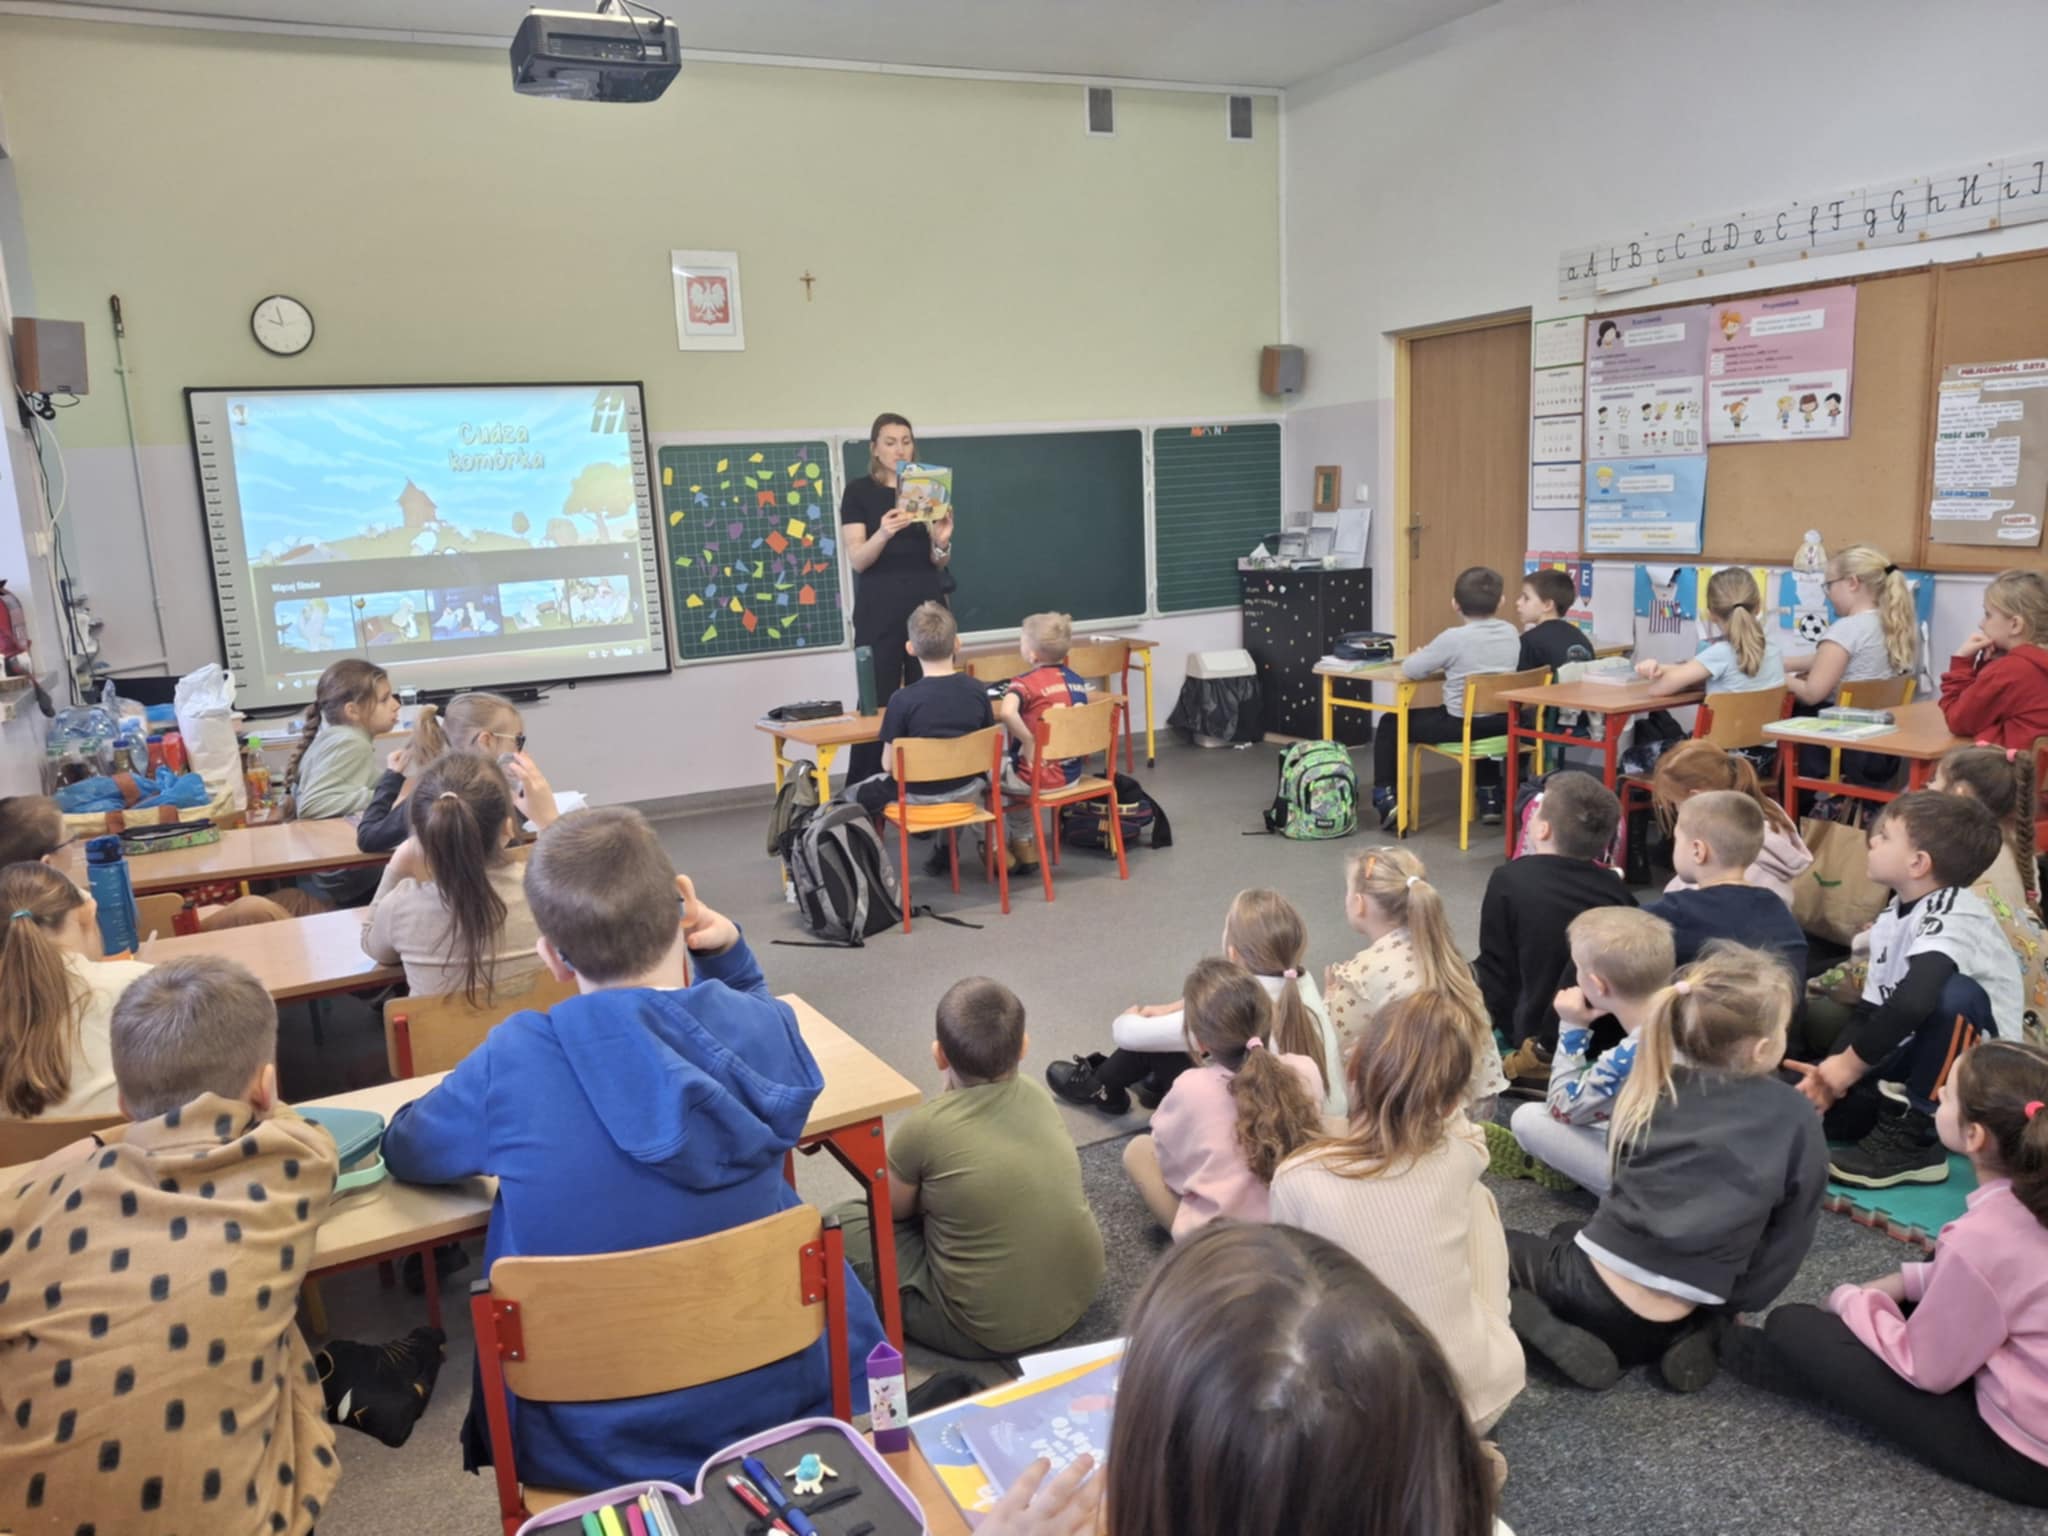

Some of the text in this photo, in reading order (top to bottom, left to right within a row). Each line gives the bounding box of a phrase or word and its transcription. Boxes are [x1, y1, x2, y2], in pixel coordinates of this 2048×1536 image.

[1568, 267, 1578, 280] a
[1584, 252, 1598, 278] A
[1611, 248, 1620, 271] b
[1628, 242, 1642, 268] B
[1656, 249, 1666, 263] c
[1675, 233, 1686, 259] C
[1702, 227, 1717, 254] d
[1723, 222, 1739, 251] D
[1754, 229, 1765, 244] e
[1776, 212, 1787, 240] E
[1808, 205, 1819, 247] f
[1828, 200, 1845, 231] F
[1863, 208, 1878, 238] g
[1891, 190, 1907, 234] G
[1927, 184, 1947, 214] h
[1957, 174, 1982, 208] H
[2003, 175, 2020, 199] i
[459, 421, 528, 446] Cudza
